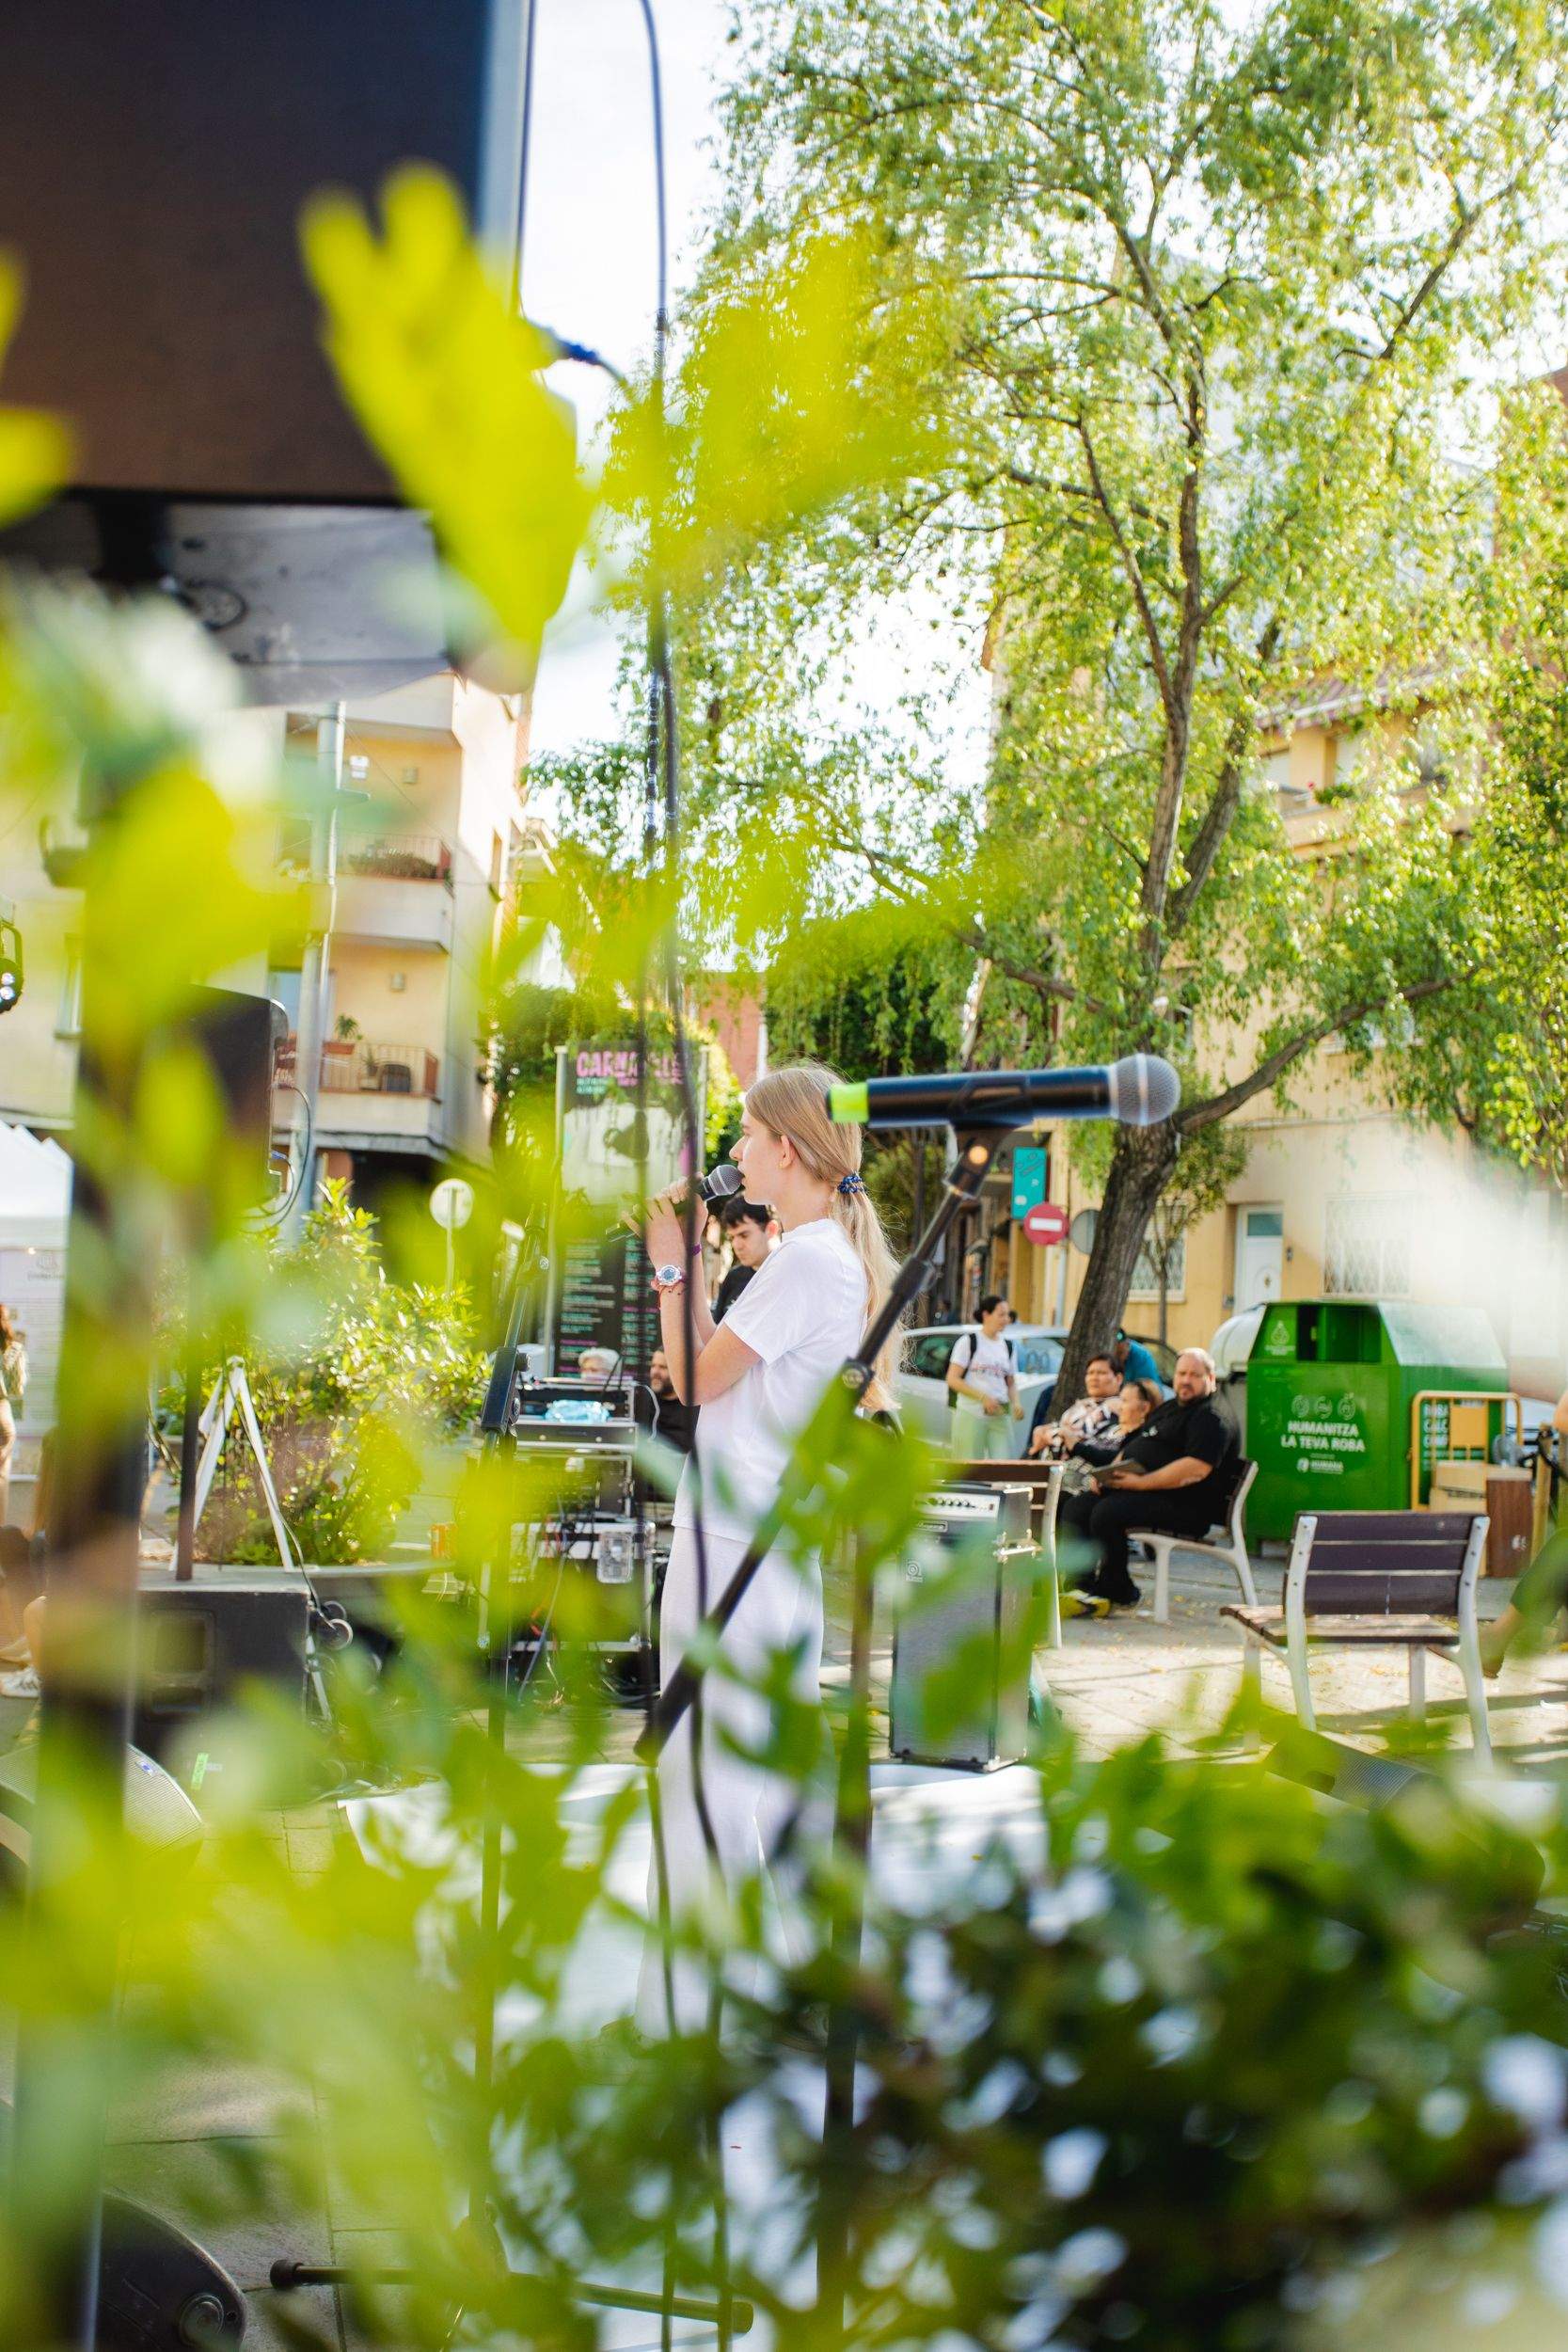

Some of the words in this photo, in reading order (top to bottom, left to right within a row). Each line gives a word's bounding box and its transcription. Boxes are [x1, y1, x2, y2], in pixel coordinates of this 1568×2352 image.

[1288, 1421, 1359, 1438] HUMANITZA
[1280, 1434, 1297, 1448] LA
[1299, 1435, 1330, 1450] TEVA
[1331, 1438, 1366, 1453] ROBA
